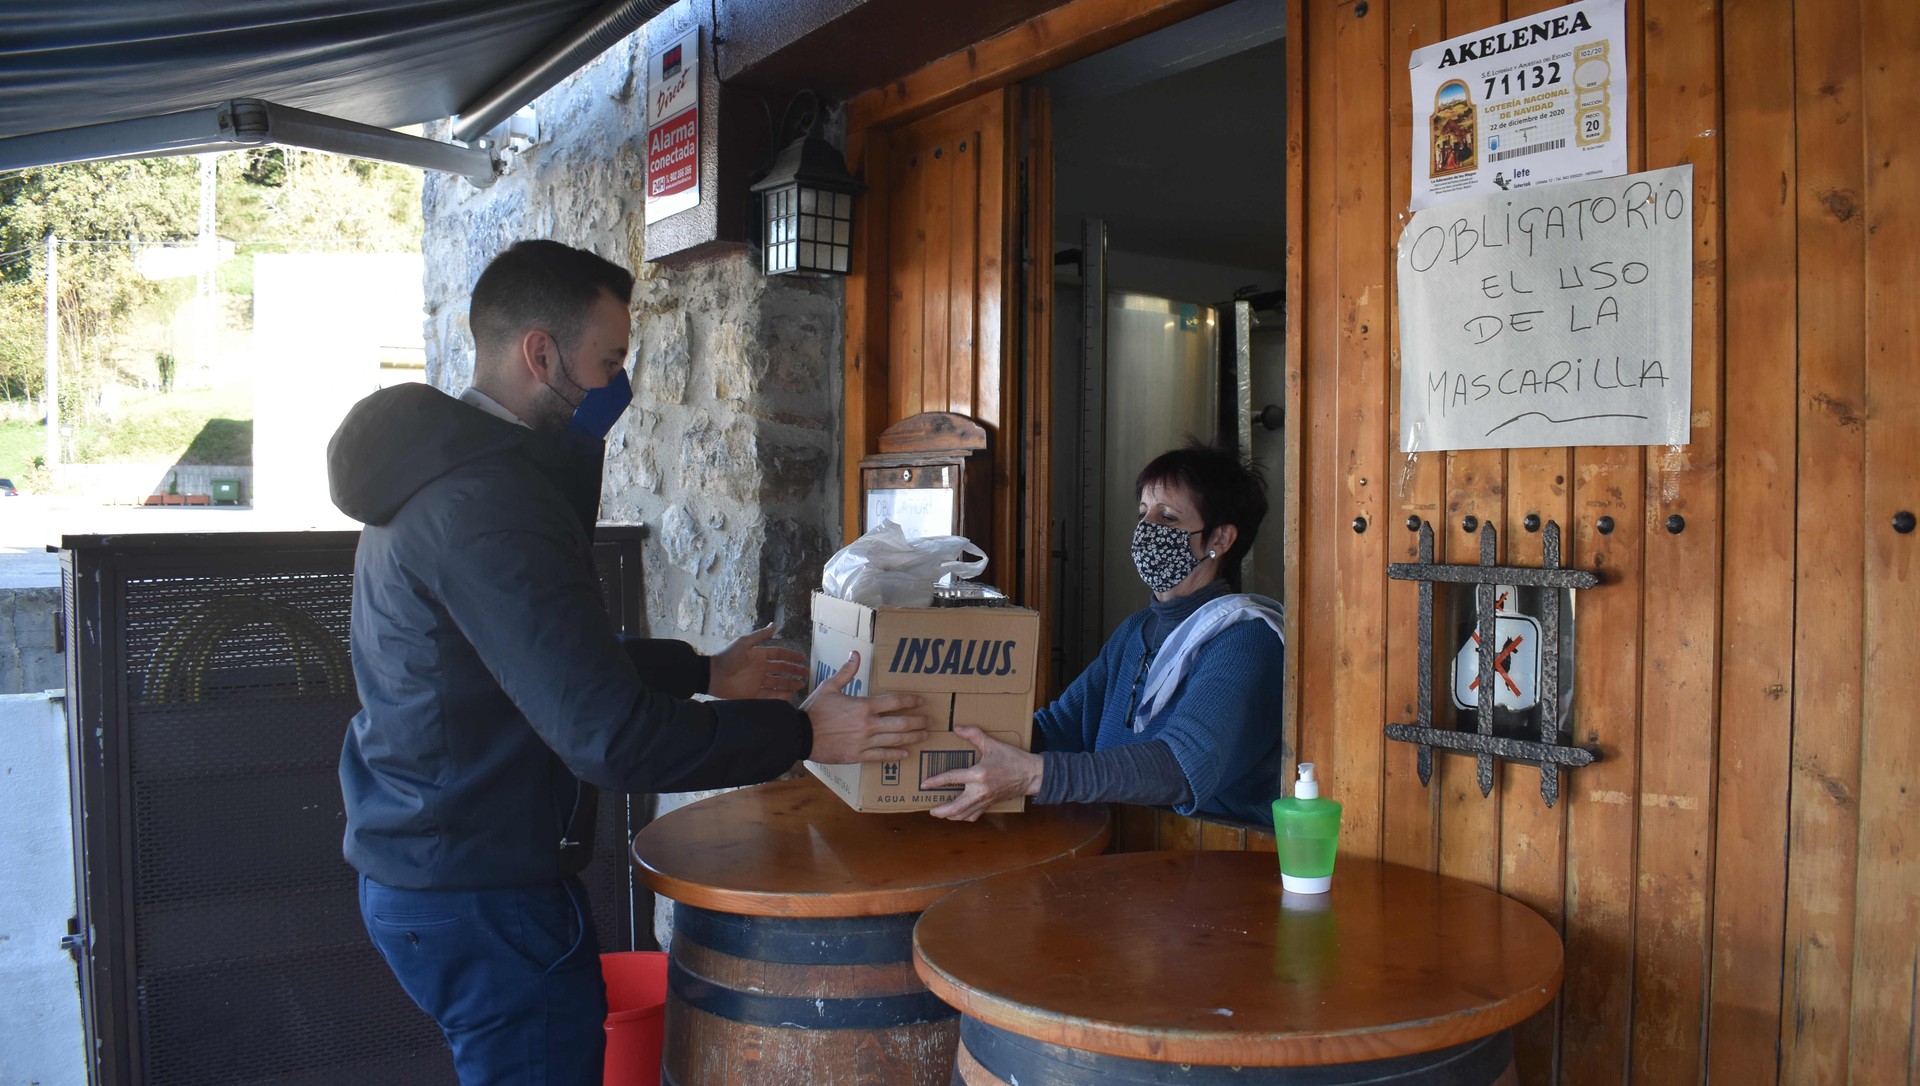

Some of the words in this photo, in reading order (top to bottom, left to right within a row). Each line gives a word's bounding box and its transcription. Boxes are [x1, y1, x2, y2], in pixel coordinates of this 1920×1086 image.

[1438, 10, 1592, 69] AKELENEA
[1484, 61, 1562, 100] 71132
[1484, 99, 1521, 114] LOTERÍA
[1523, 88, 1570, 105] NACIONAL
[1499, 112, 1512, 120] DE
[1513, 101, 1554, 117] NAVIDAD
[1490, 123, 1498, 131] 22
[1498, 121, 1507, 129] de
[1508, 114, 1539, 128] diciembre
[1549, 108, 1566, 118] 2020
[1585, 119, 1600, 132] 20
[651, 120, 695, 156] Alarma
[650, 142, 695, 173] conectada
[1410, 181, 1684, 272] OBLIGATORIO
[1481, 270, 1533, 299] EL
[1559, 261, 1649, 291] USO
[1463, 310, 1544, 345] DE
[1570, 296, 1619, 333] LA
[1427, 356, 1669, 418] MASCARILLA
[877, 795, 905, 803] AGUA
